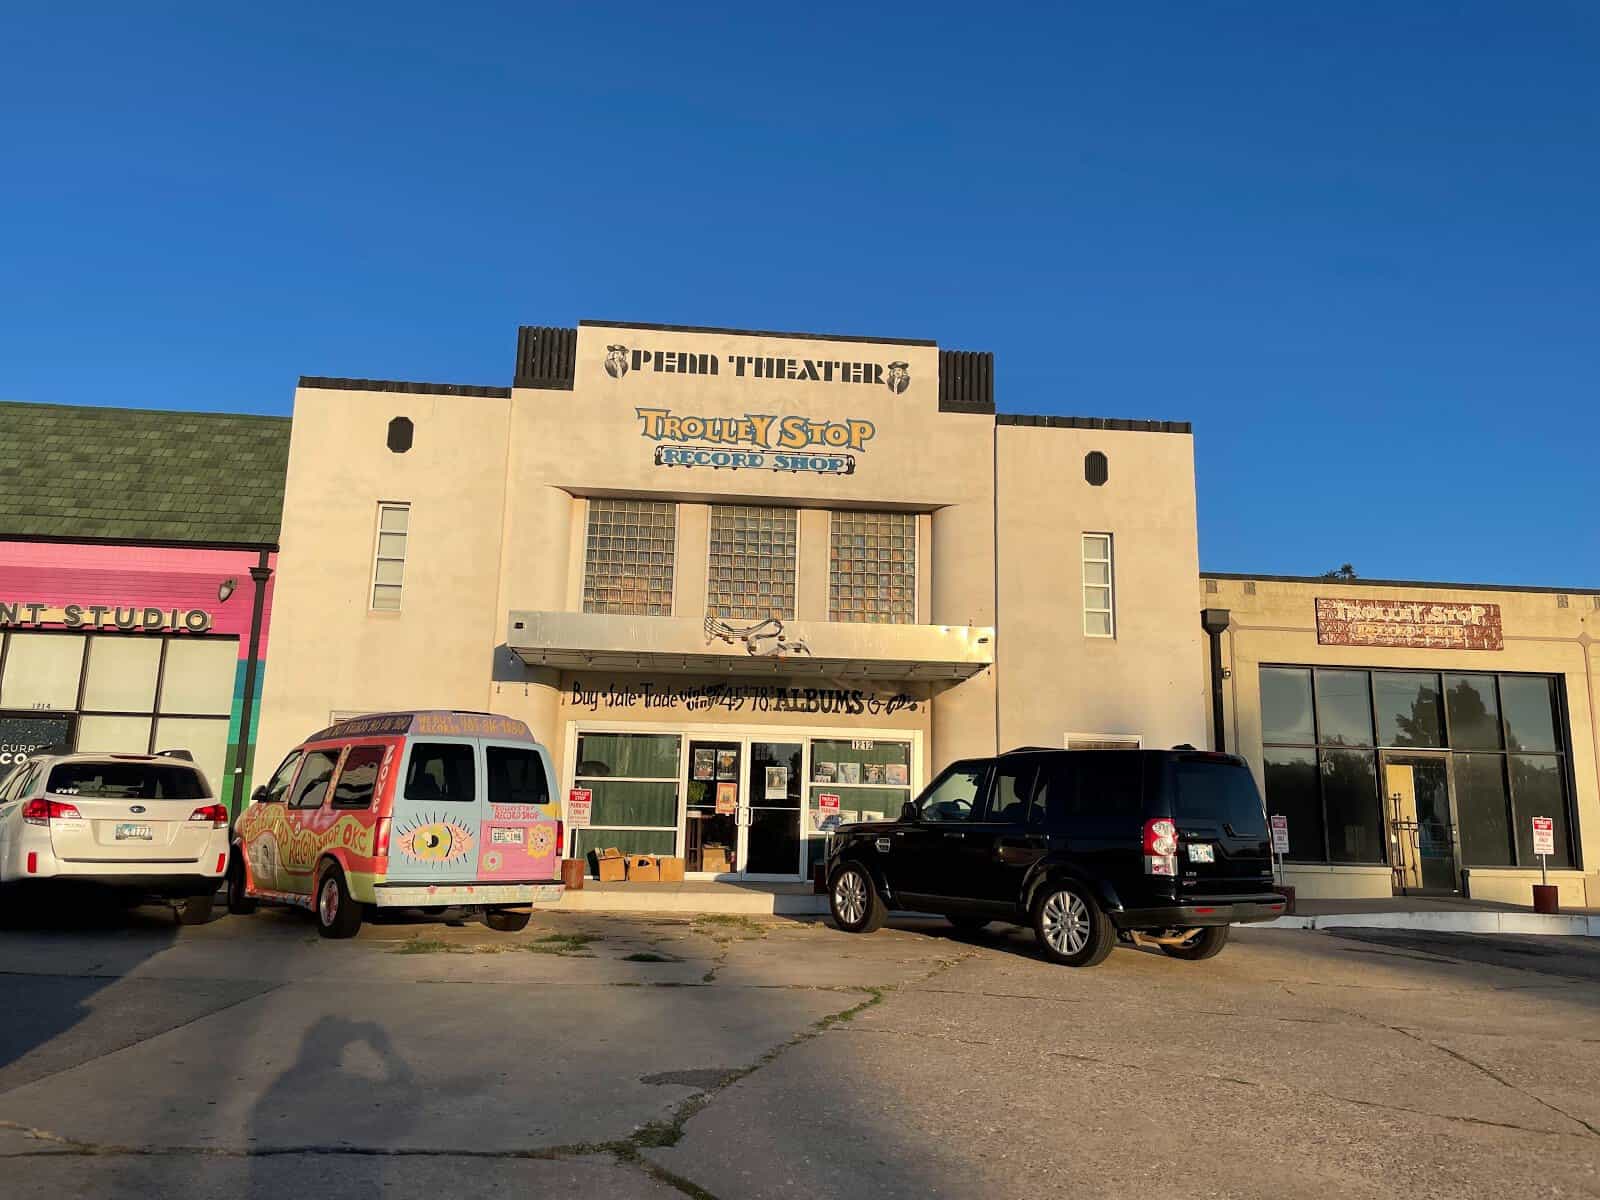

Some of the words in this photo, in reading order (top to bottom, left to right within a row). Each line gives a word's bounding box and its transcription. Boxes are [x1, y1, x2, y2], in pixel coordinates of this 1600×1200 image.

[631, 349, 719, 375] PENN
[728, 355, 886, 385] THEATER
[634, 407, 776, 449] TROLLEY
[776, 415, 876, 452] STOP
[663, 447, 764, 467] RECORD
[773, 454, 845, 472] SHOP
[63, 604, 210, 632] STUDIO
[571, 680, 599, 712] Buy
[640, 682, 678, 709] Trade
[773, 687, 865, 715] ALBUMS
[1, 743, 42, 753] CURR
[342, 823, 368, 852] OKC
